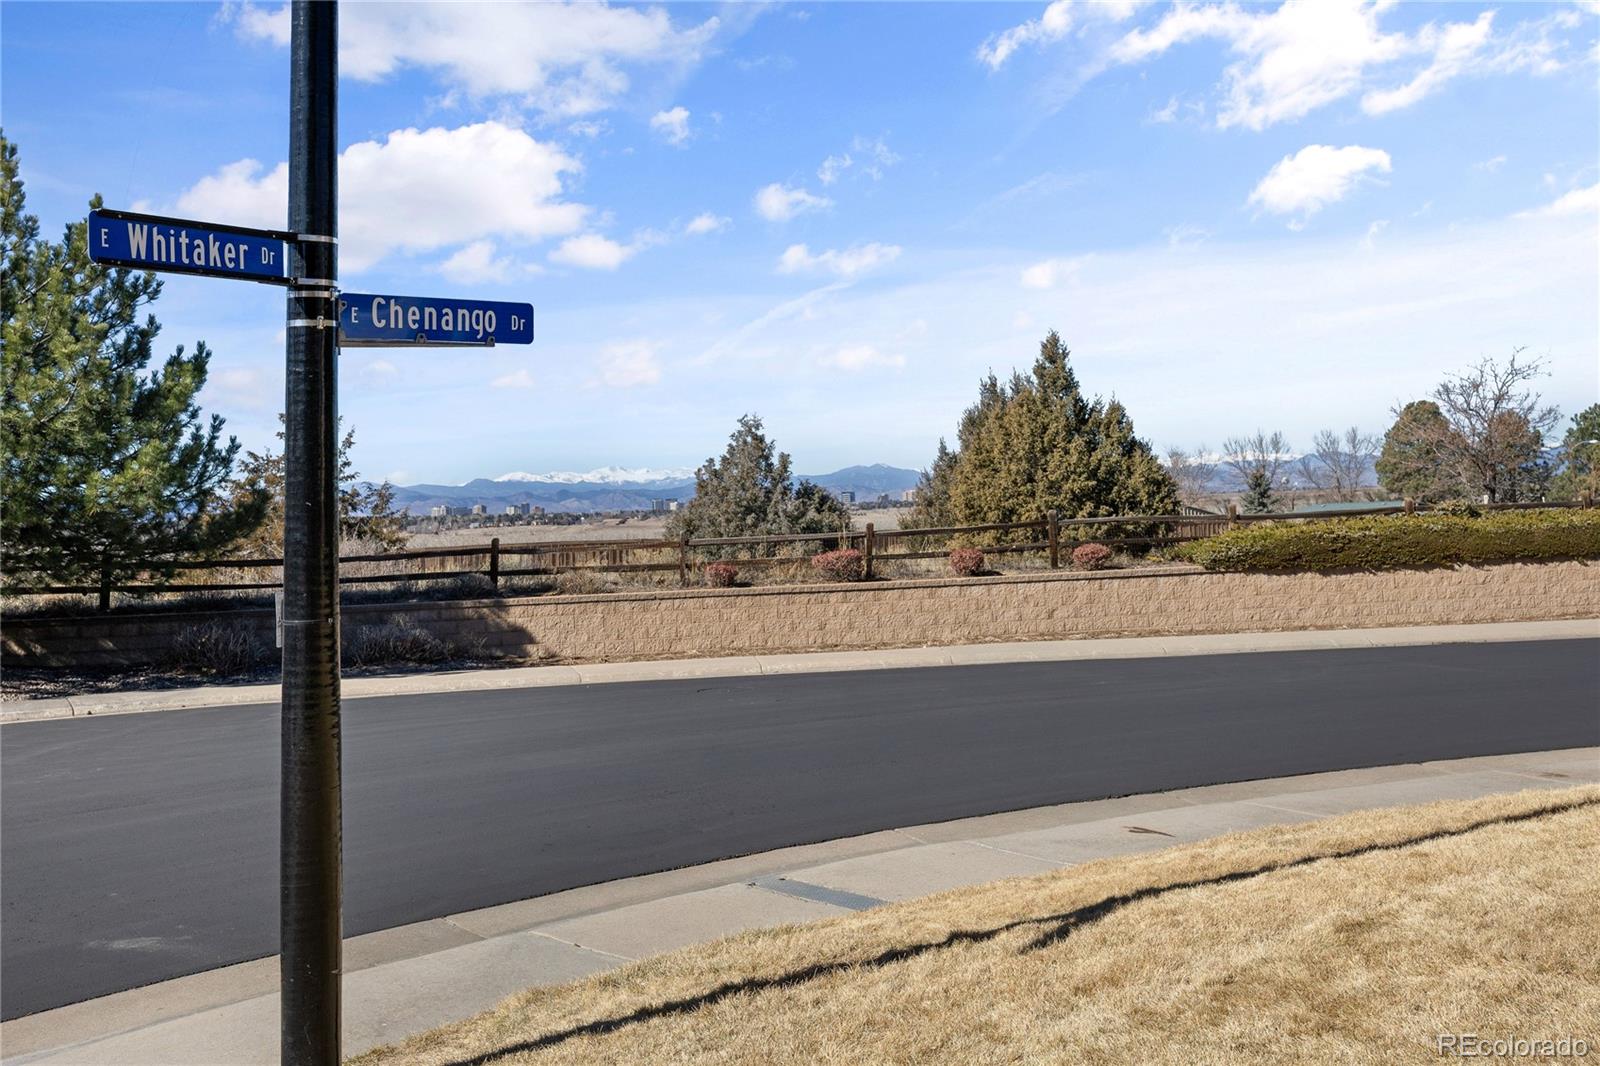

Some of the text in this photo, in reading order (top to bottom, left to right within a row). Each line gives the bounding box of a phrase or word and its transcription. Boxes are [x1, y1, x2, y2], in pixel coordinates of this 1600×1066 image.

[101, 222, 275, 270] E Whitaker Dr
[351, 297, 526, 339] E Chenango Dr
